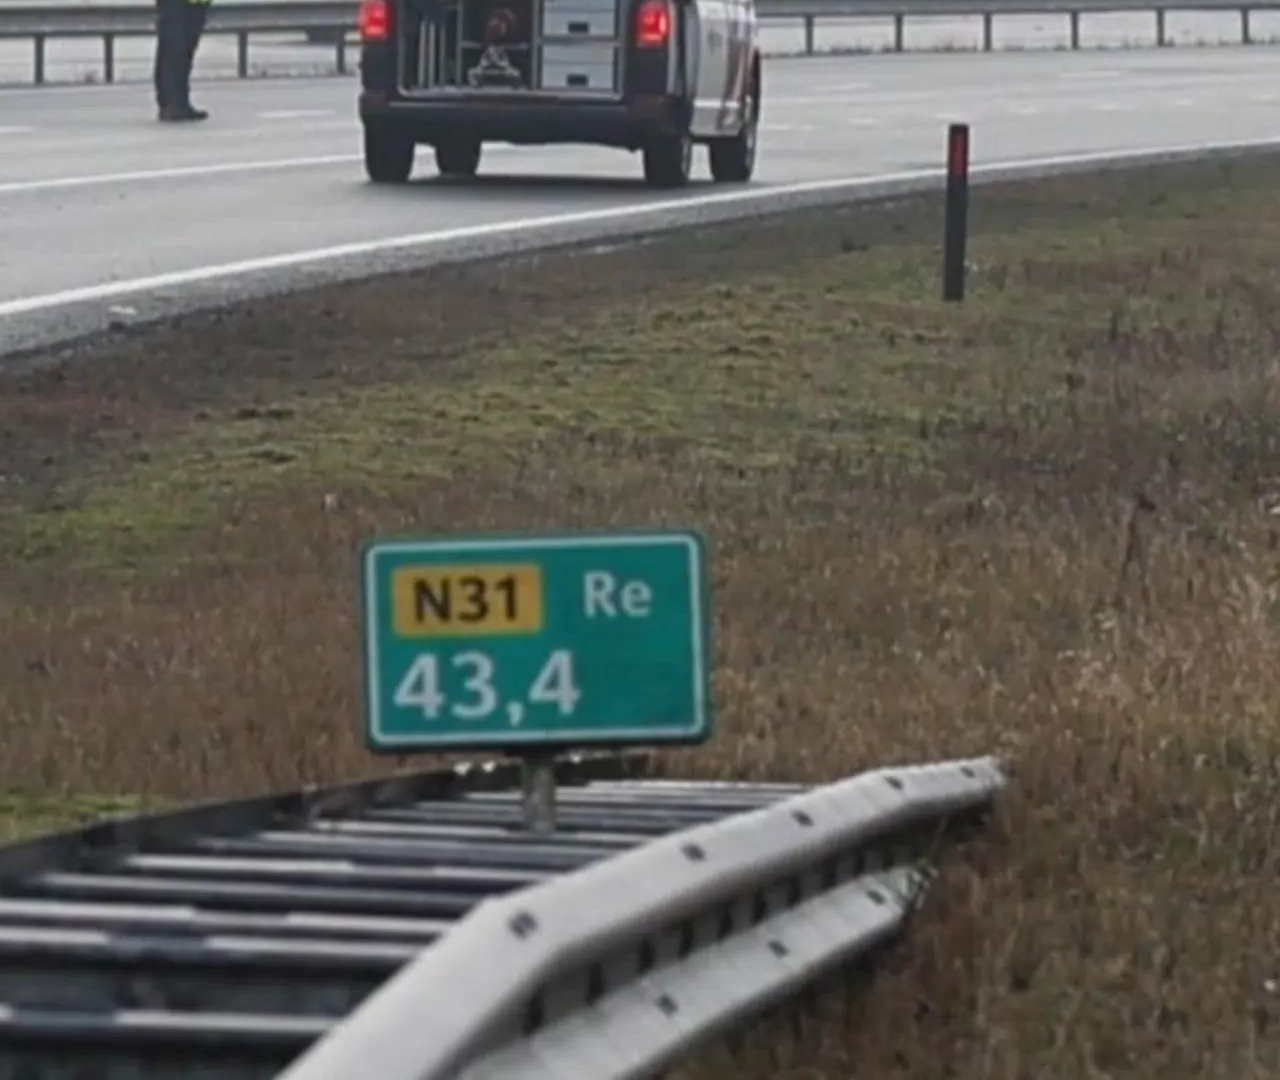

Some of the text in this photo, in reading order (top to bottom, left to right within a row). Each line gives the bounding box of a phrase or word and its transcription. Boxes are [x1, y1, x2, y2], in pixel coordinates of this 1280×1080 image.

[412, 570, 653, 624] N31 Re
[392, 649, 582, 727] 43,4
